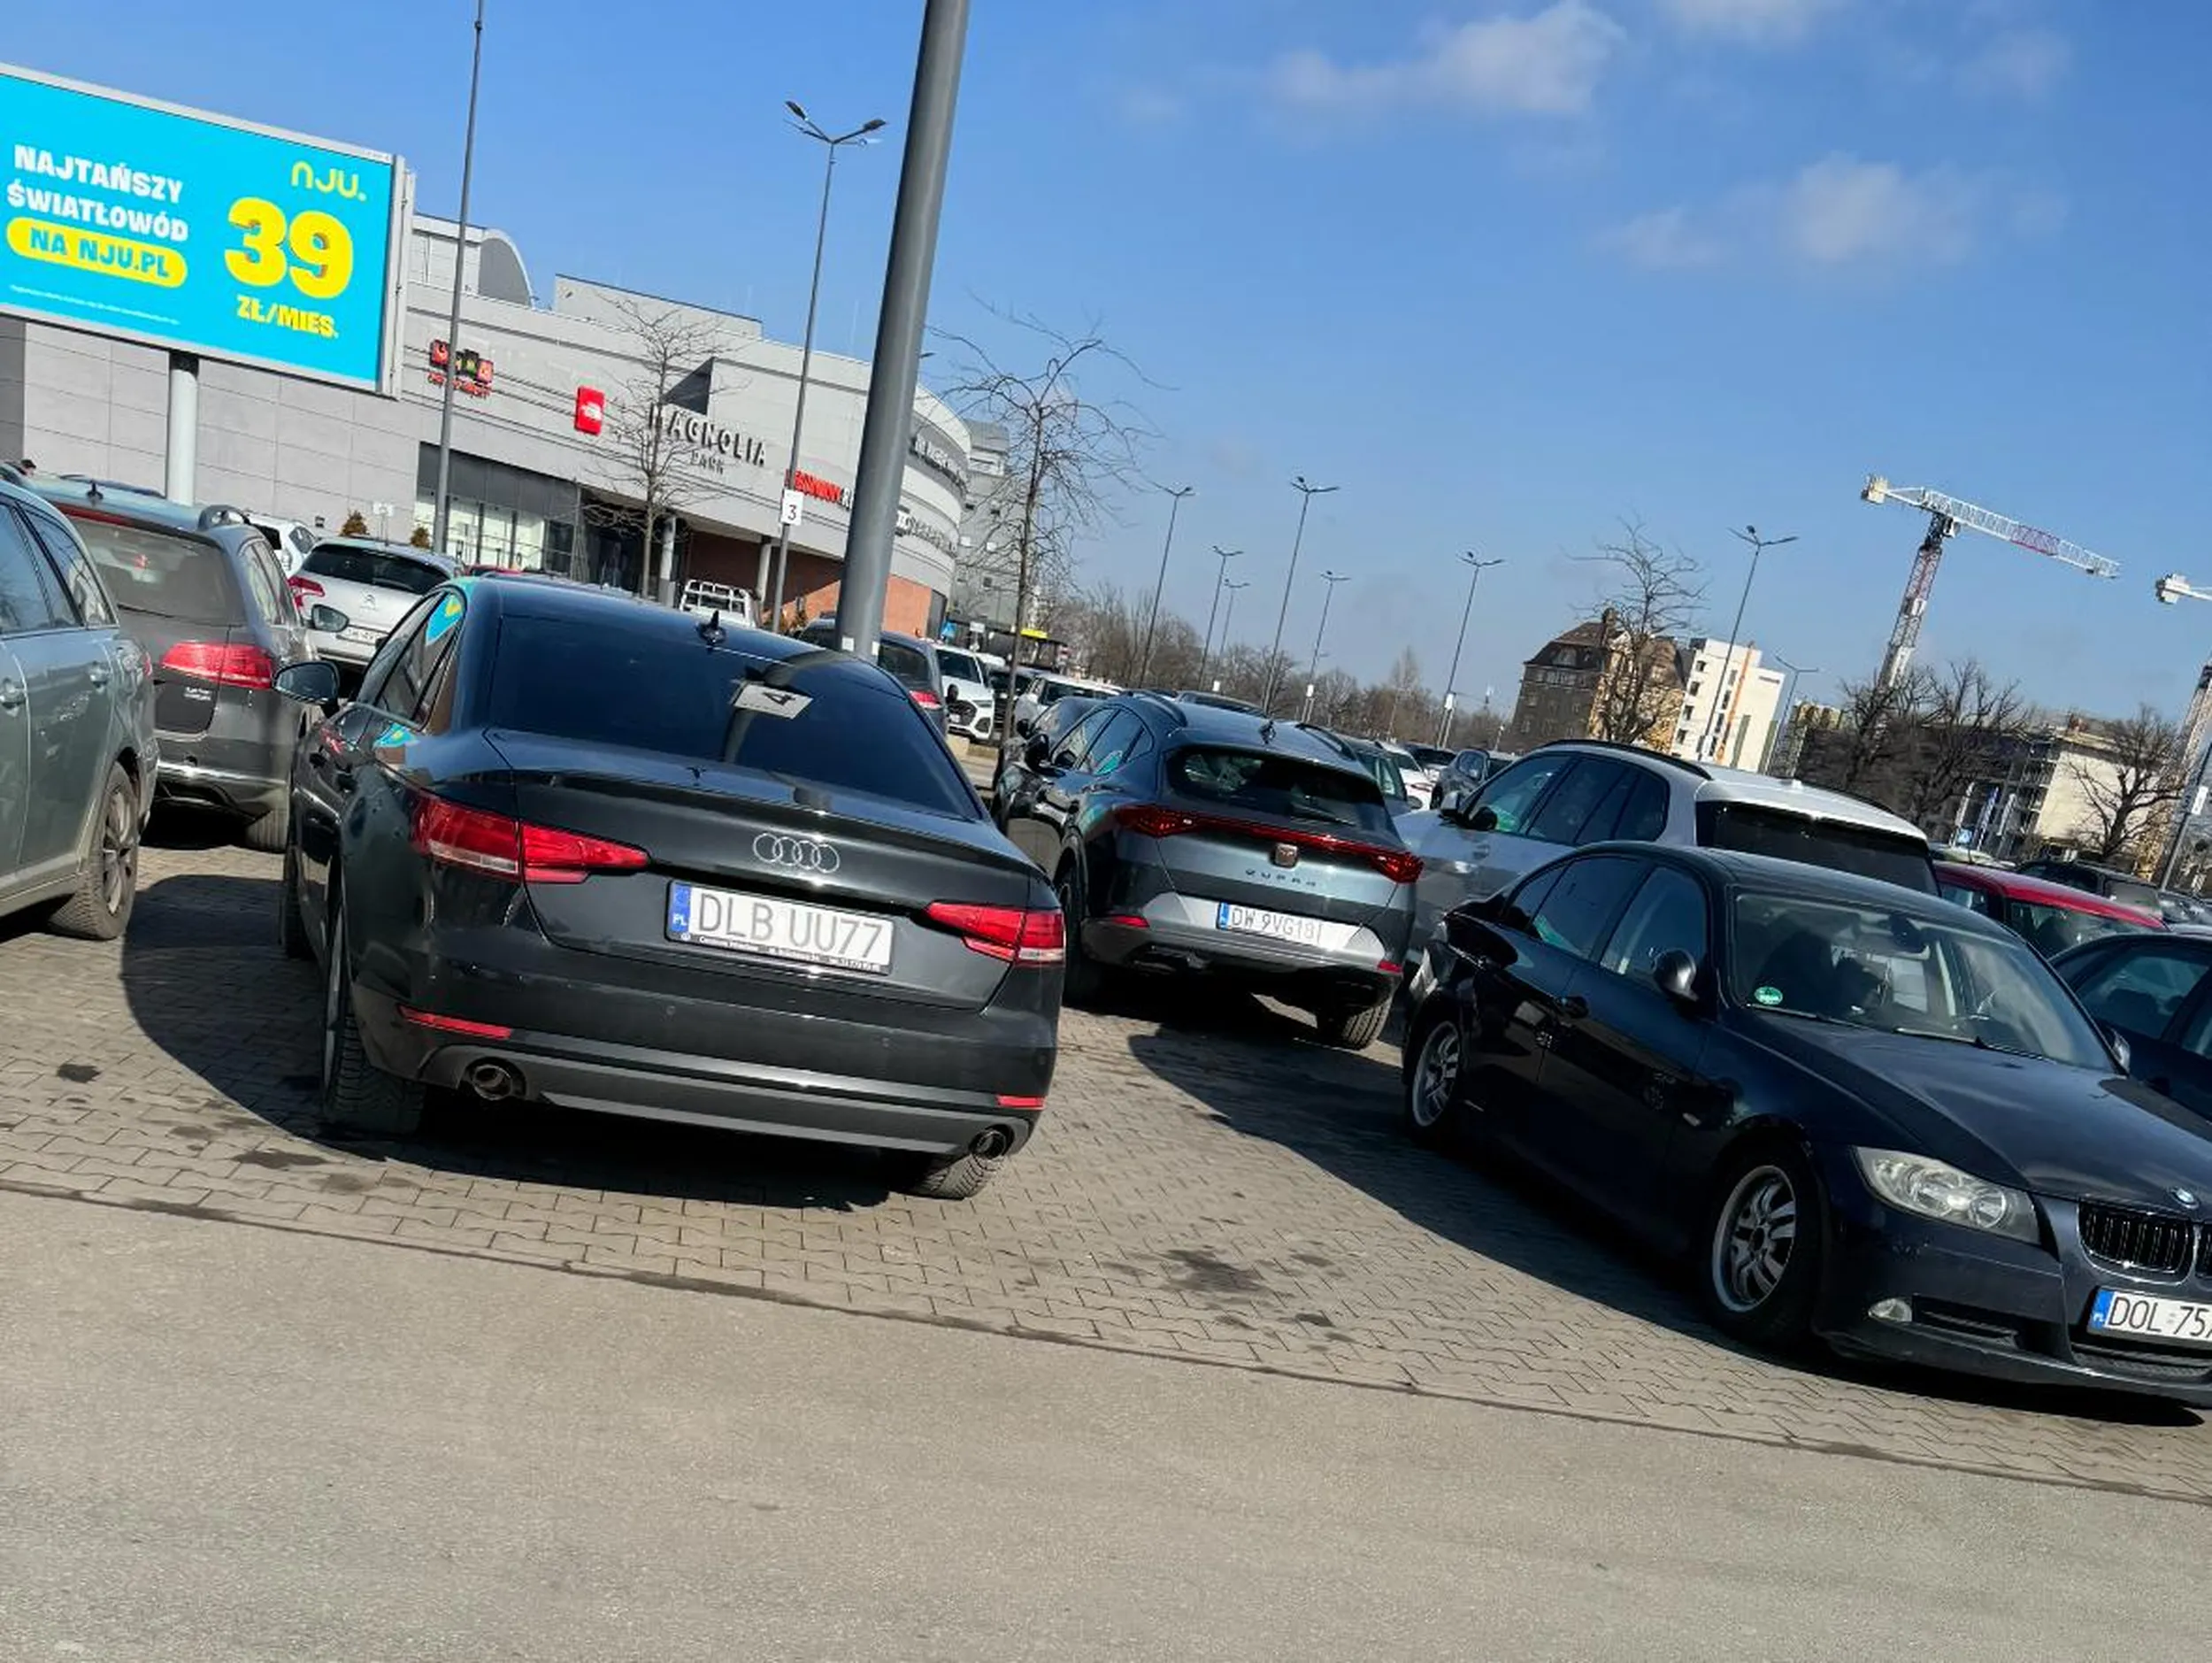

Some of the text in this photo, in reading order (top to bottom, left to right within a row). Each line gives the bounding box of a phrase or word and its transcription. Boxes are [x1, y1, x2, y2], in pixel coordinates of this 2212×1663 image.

[14, 144, 182, 204] NAJTAŃSZY
[7, 181, 188, 242] ŚWIATŁOWÓD
[29, 228, 169, 278] NA NJU.PL
[225, 197, 353, 297] 39
[236, 296, 339, 338] ZŁ/MIES.
[787, 504, 797, 521] 3
[699, 893, 773, 941] DLB
[790, 910, 882, 958] UU77
[1232, 908, 1256, 928] DW
[2108, 1297, 2212, 1338] DOL 75
